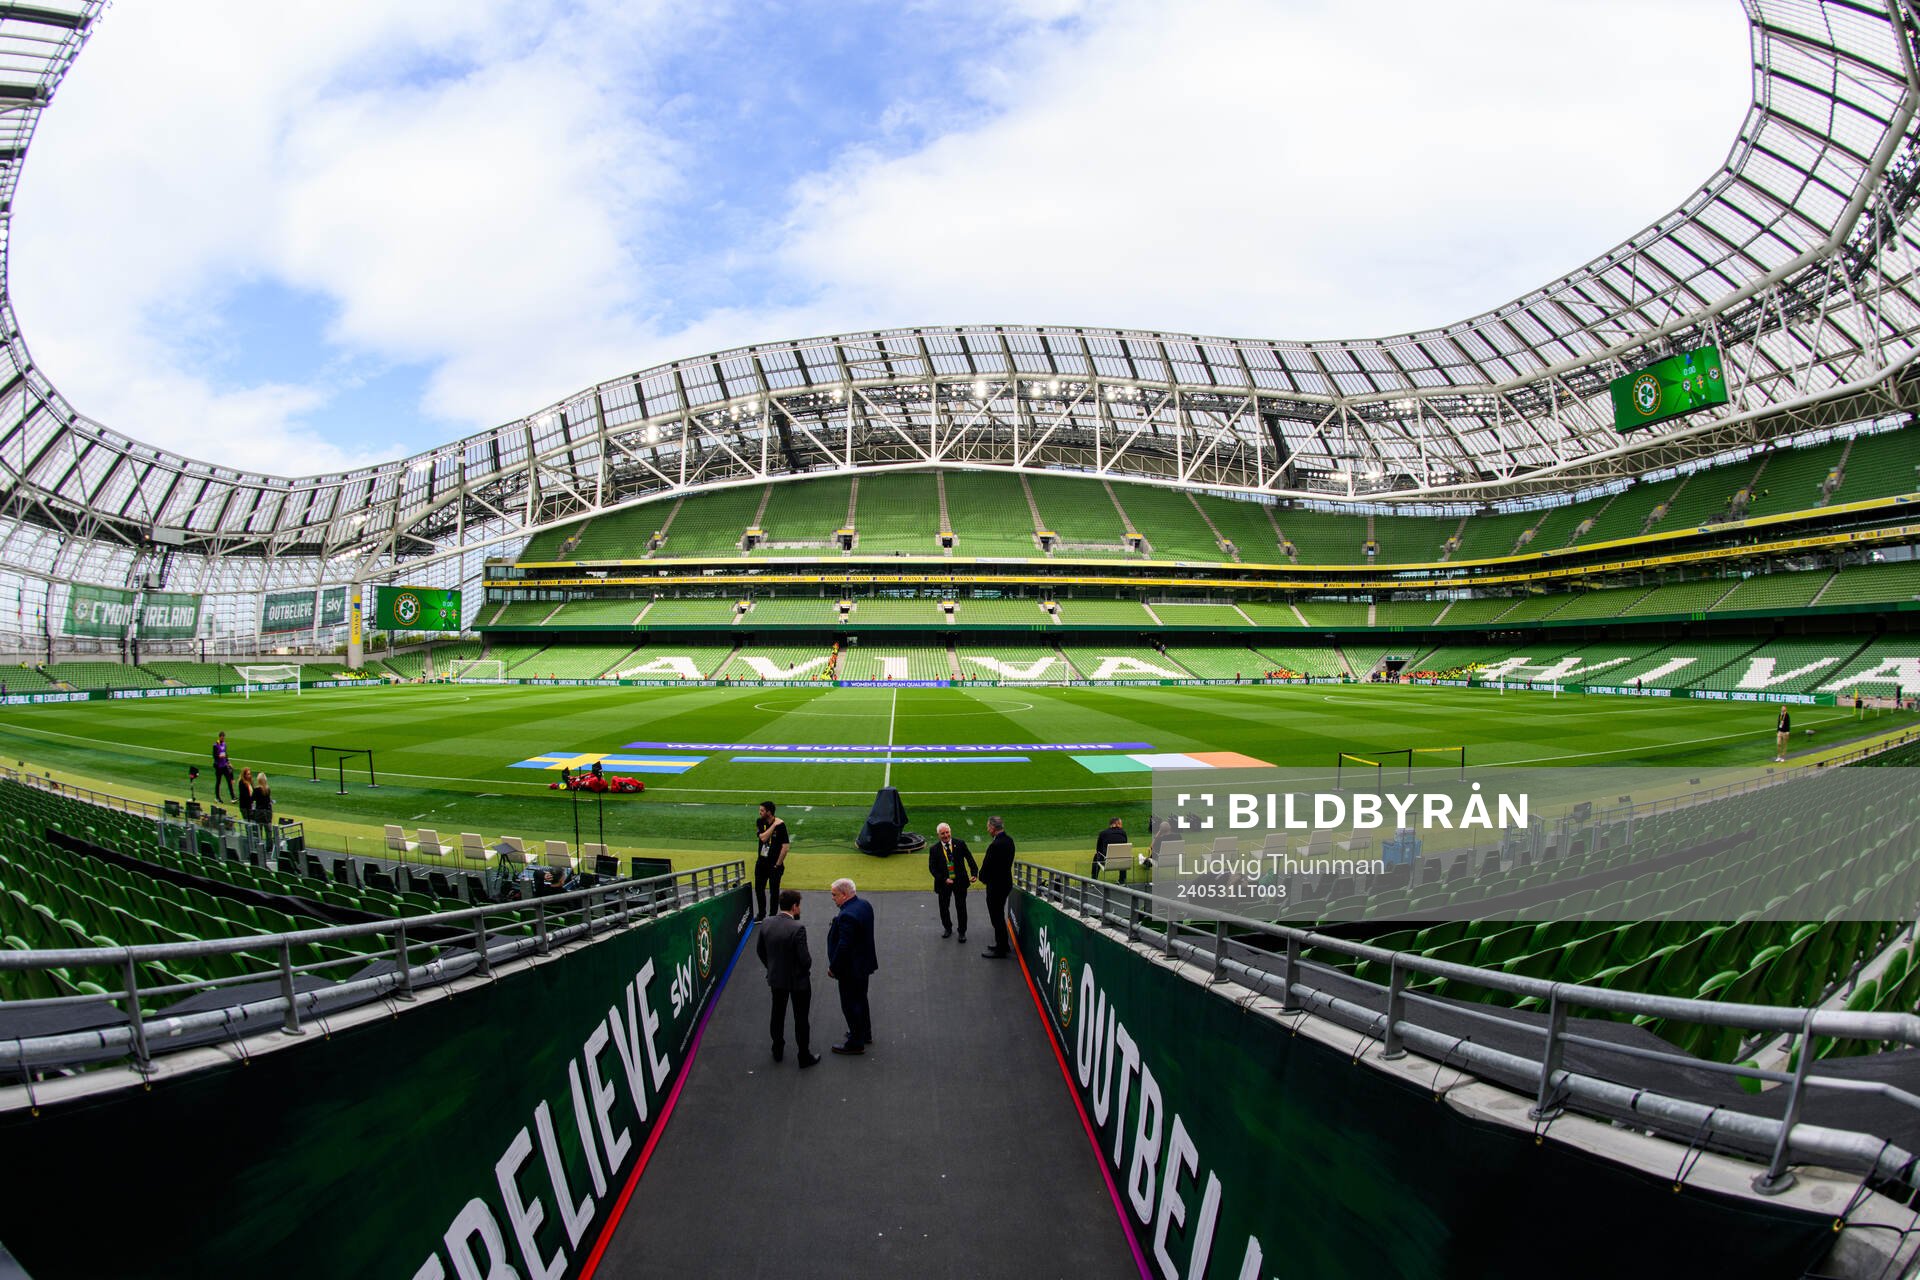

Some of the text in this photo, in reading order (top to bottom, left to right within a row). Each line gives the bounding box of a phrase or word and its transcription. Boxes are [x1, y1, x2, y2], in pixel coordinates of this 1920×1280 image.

[90, 602, 194, 626] C'MON IRELAND
[268, 602, 313, 620] OUTBELIEVE
[326, 598, 342, 613] sky
[1038, 925, 1054, 984] sky
[670, 954, 692, 1020] sky
[412, 956, 670, 1280] BELIEVE
